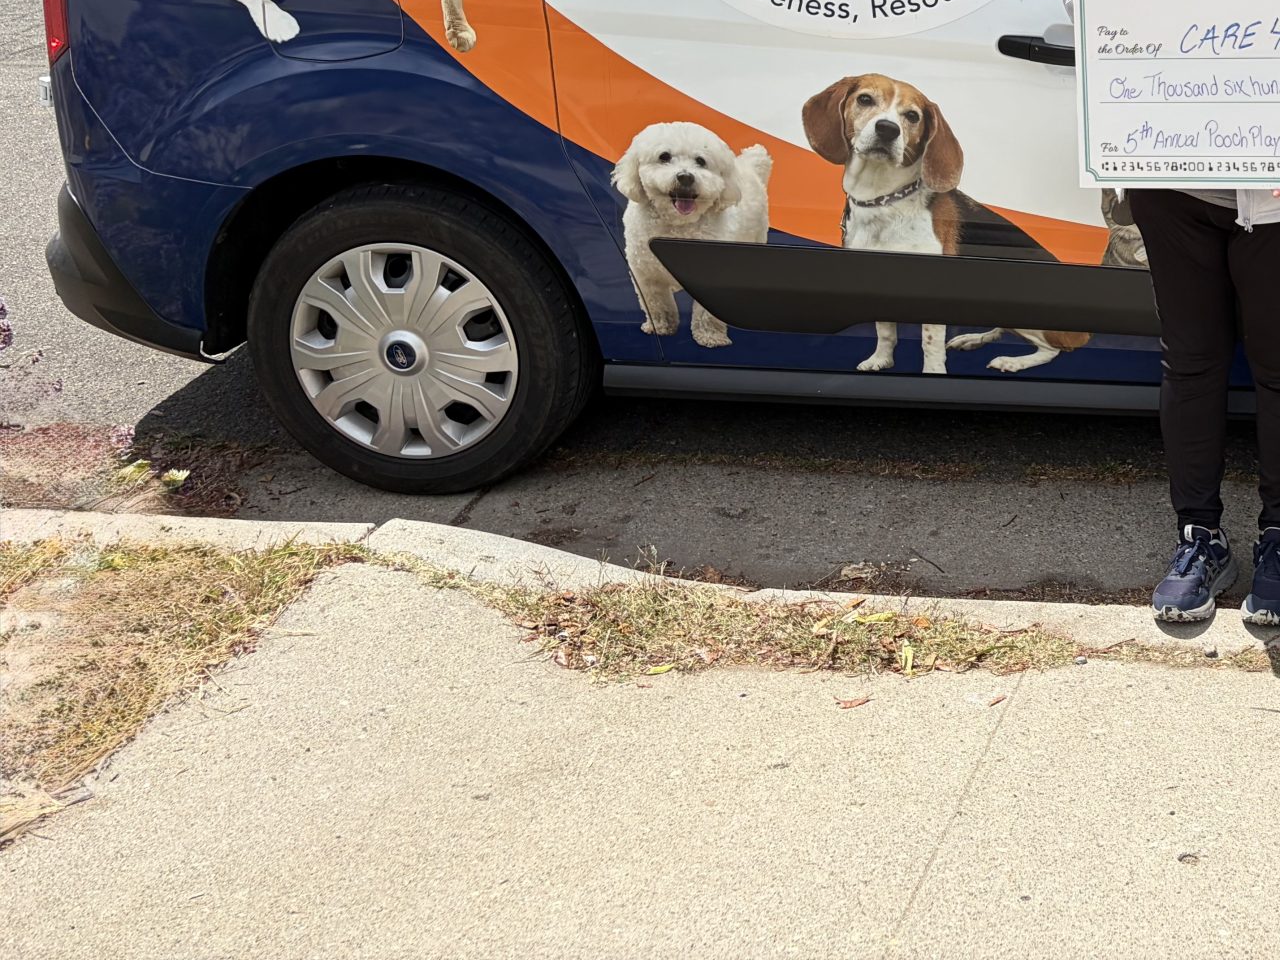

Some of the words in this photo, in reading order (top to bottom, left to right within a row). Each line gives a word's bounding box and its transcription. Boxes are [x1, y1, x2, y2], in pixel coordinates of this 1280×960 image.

[1097, 25, 1119, 43] Pay
[1119, 27, 1129, 37] to
[1179, 20, 1263, 56] CARE
[1097, 43, 1113, 55] the
[1114, 43, 1145, 55] Order
[1145, 42, 1163, 58] Of
[1109, 76, 1143, 100] One
[1144, 71, 1219, 101] Thousand
[1224, 78, 1251, 97] six
[1100, 142, 1119, 153] For
[1123, 120, 1153, 155] 5th
[1204, 119, 1248, 148] Pooch
